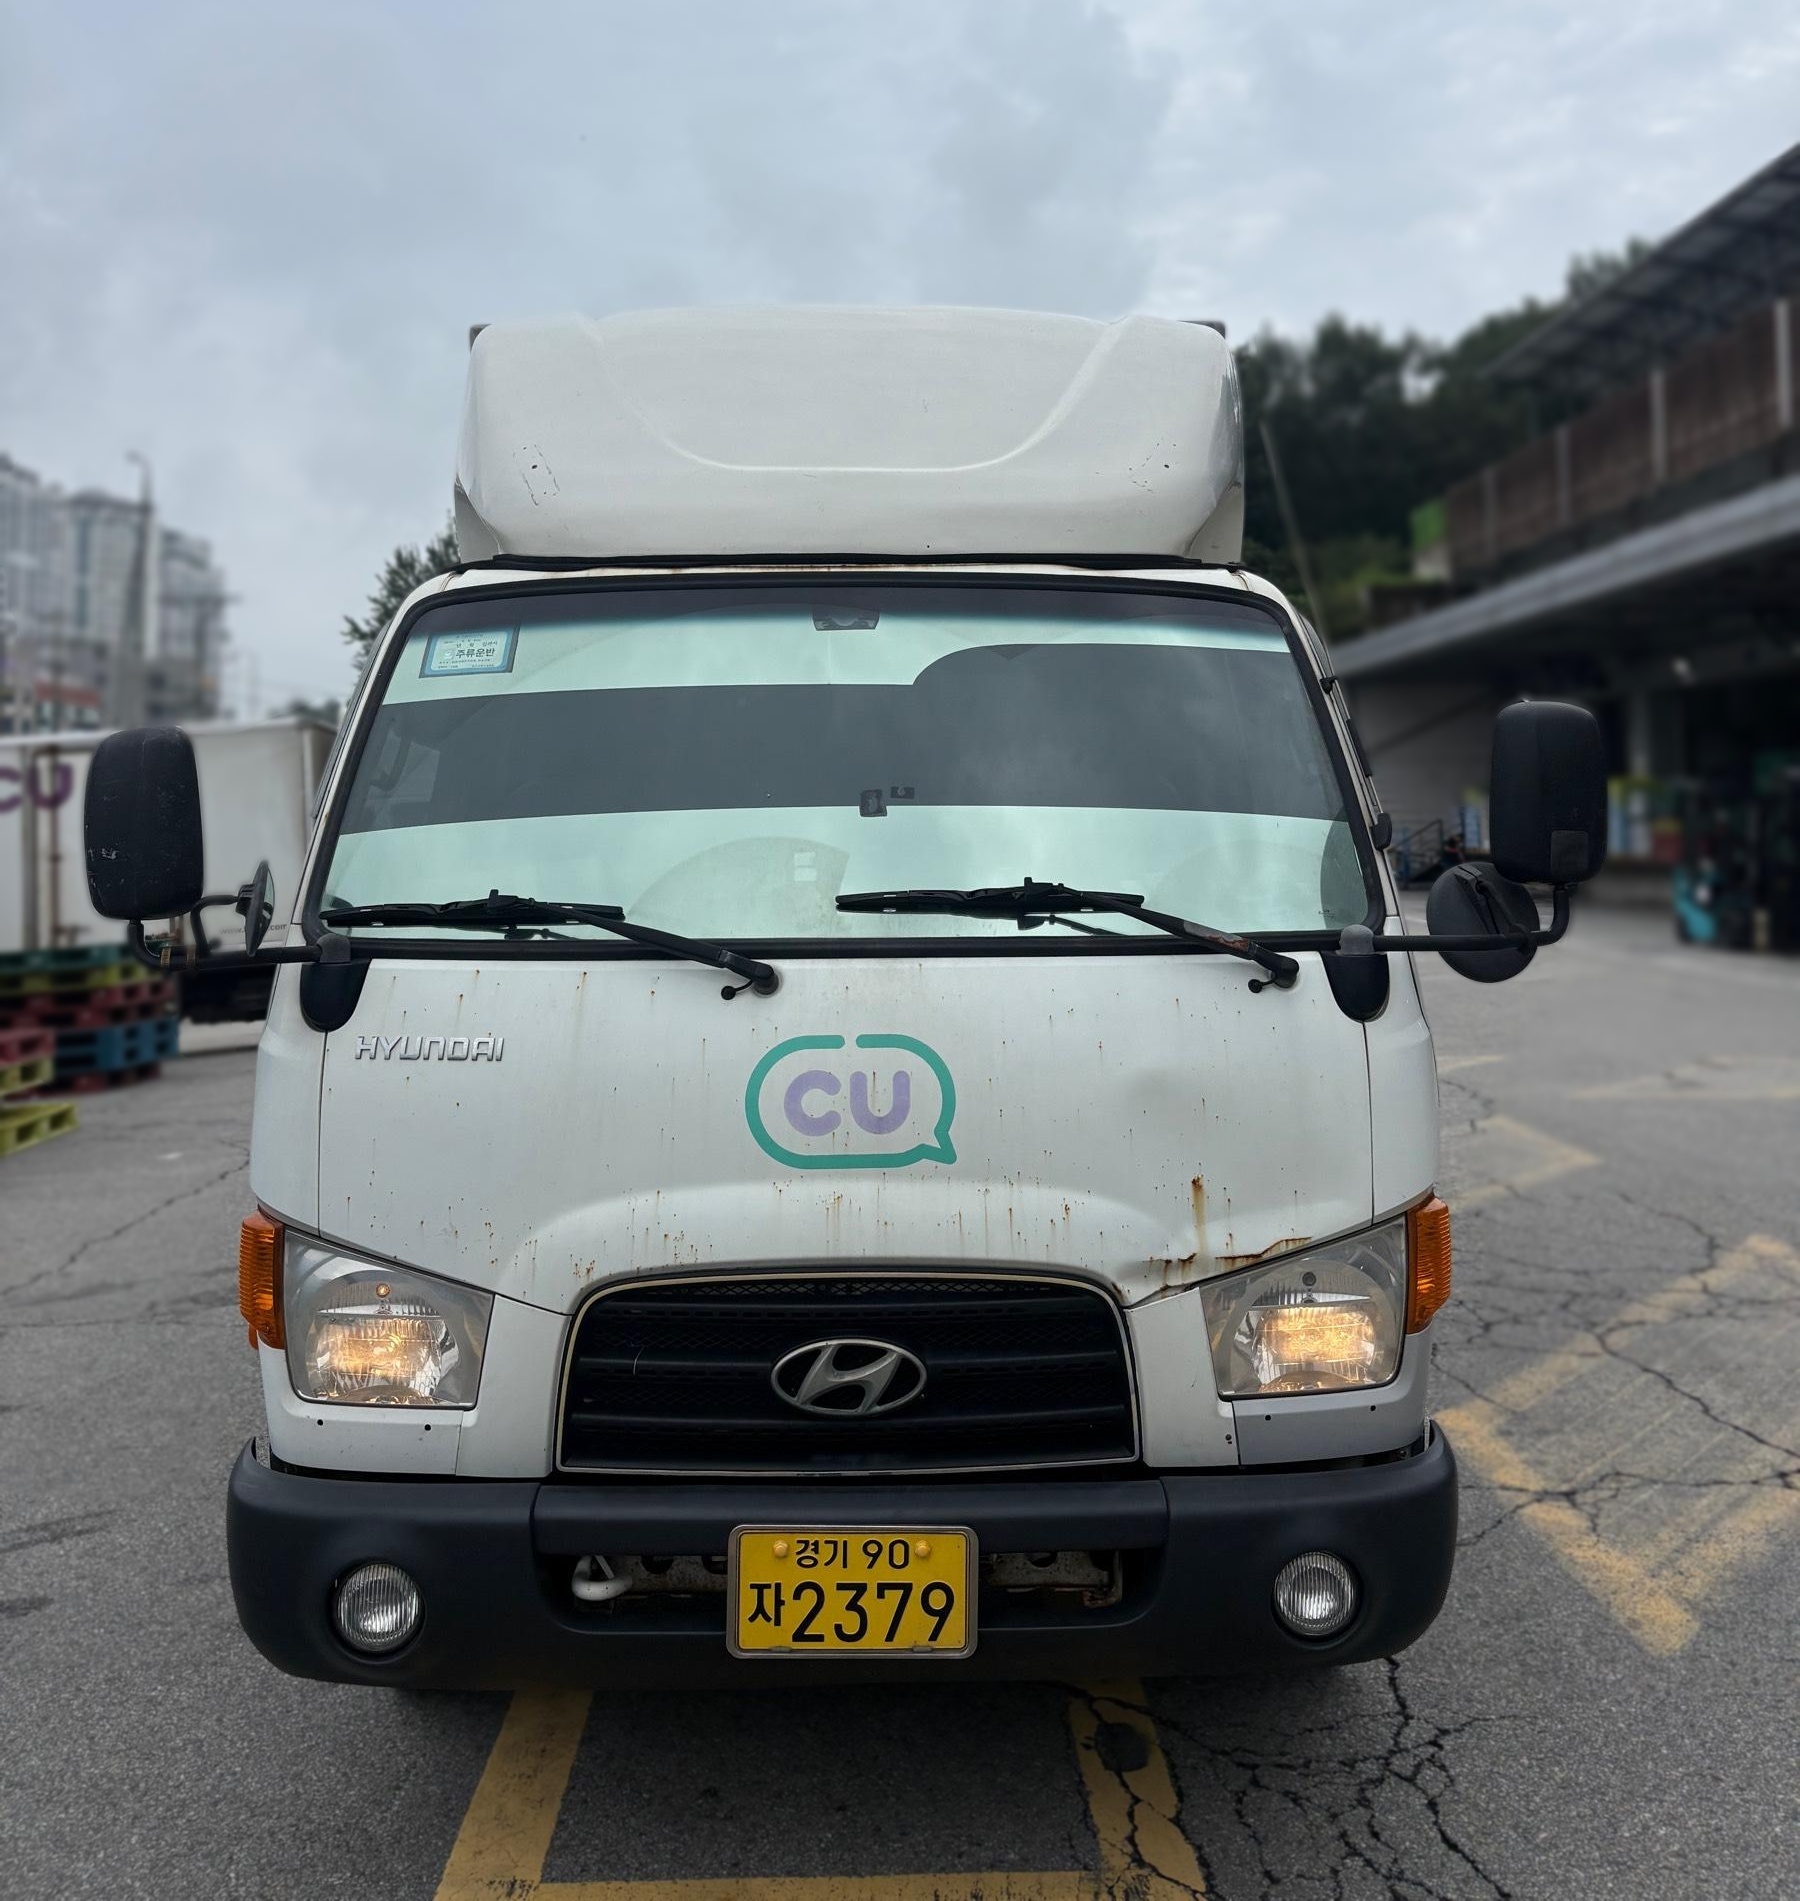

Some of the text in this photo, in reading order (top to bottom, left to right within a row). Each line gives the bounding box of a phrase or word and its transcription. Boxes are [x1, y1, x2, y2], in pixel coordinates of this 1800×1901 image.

[456, 648, 495, 658] 주류운반
[355, 1036, 504, 1062] HYUNDAI
[783, 1070, 911, 1137] CU
[795, 1539, 910, 1569] 경기 90
[747, 1581, 955, 1643] 자2379
